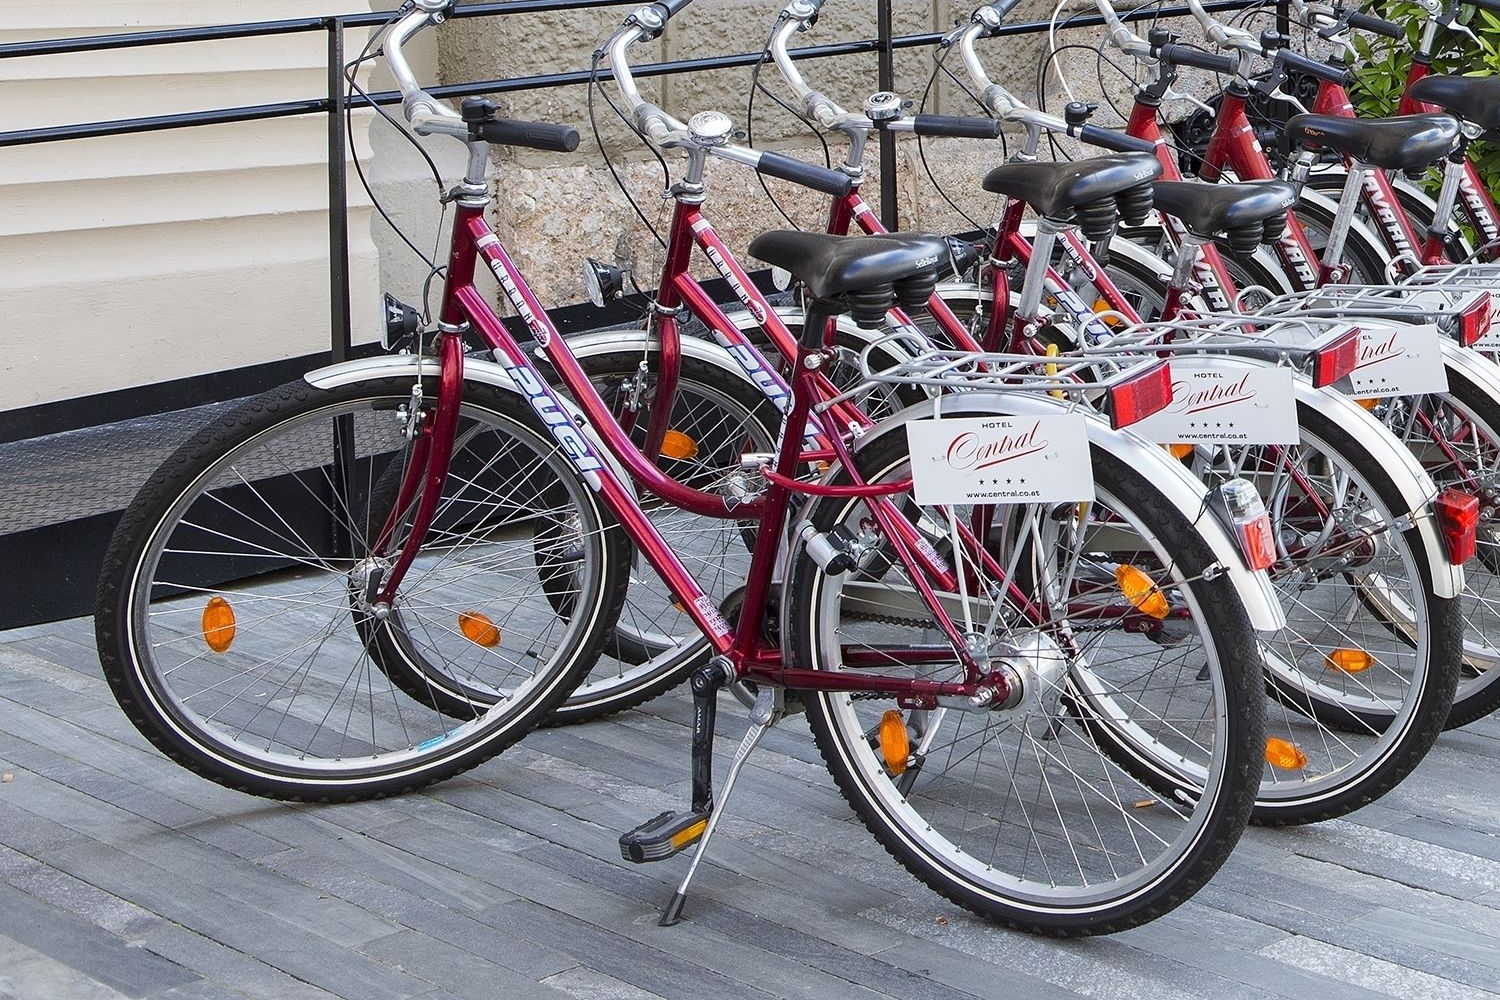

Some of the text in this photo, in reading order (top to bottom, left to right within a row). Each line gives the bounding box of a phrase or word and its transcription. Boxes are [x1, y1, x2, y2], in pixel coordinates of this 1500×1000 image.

[1360, 331, 1406, 361] tral
[1164, 371, 1258, 414] Central
[981, 421, 1013, 429] HOTEL
[946, 419, 1049, 471] Central
[966, 490, 1041, 498] www.central.co.at
